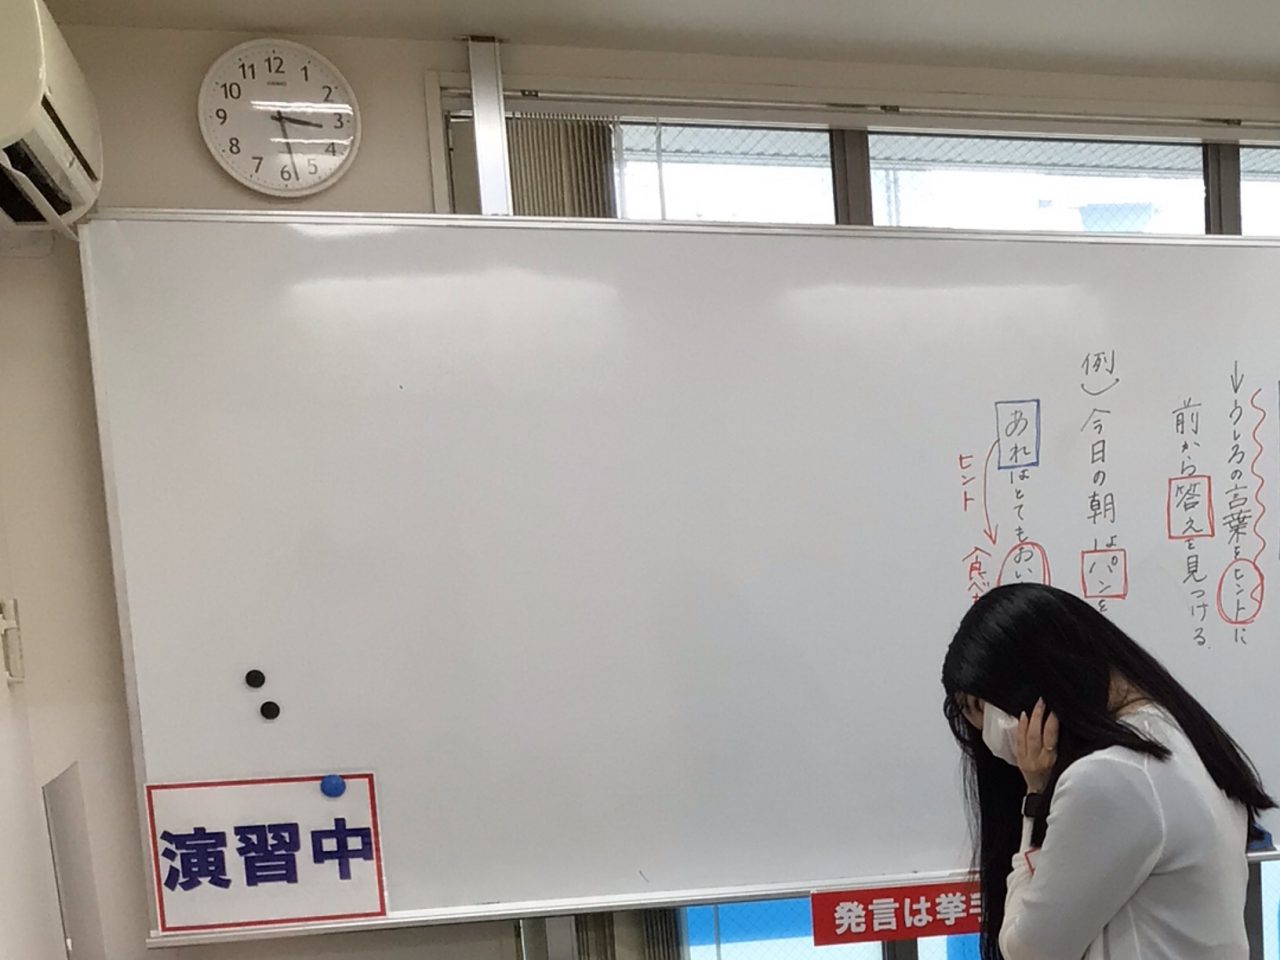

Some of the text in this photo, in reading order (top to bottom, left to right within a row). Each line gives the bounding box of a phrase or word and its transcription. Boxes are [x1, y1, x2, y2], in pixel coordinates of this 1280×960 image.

[239, 63, 256, 79] 11
[264, 57, 285, 74] 12
[301, 66, 309, 81] 1
[221, 82, 241, 99] 10
[322, 86, 333, 102] 2
[216, 109, 228, 125] 9
[333, 113, 344, 129] 3
[229, 137, 241, 155] 8
[325, 142, 336, 156] 4
[252, 157, 264, 173] 7
[280, 165, 292, 181] 6
[307, 159, 318, 175] 5
[959, 453, 976, 512] ヒント
[160, 817, 375, 891] 演習中
